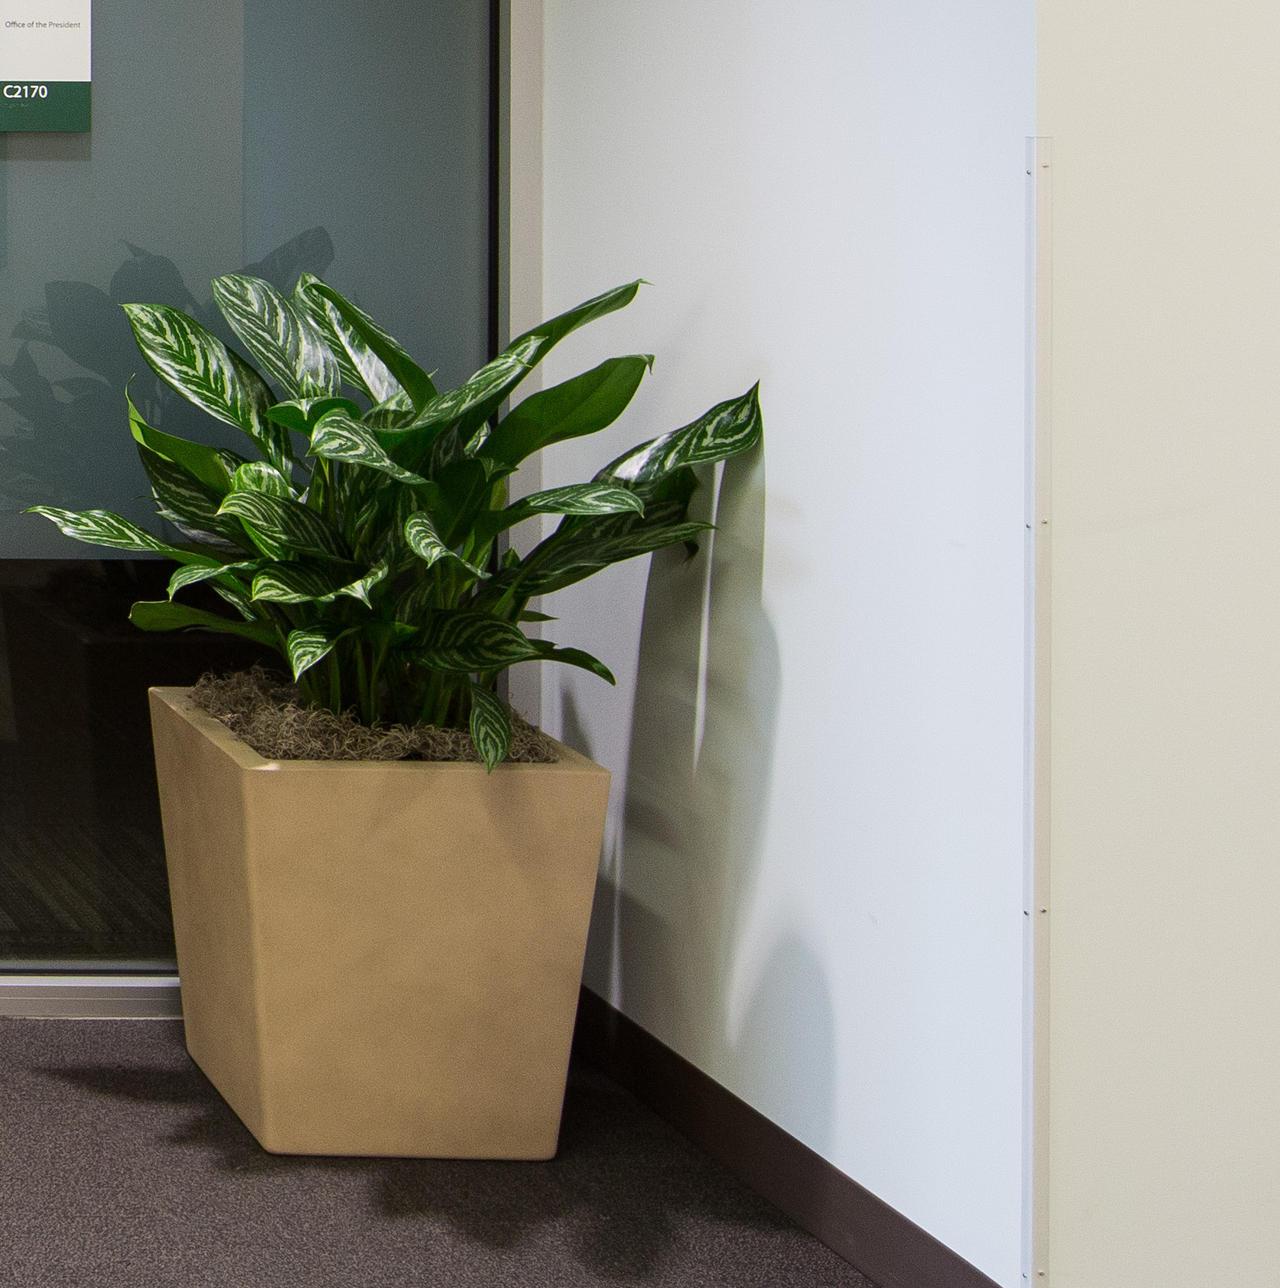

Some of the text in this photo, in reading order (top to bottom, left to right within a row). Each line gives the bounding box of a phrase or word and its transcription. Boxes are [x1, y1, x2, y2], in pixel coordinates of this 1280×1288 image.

[4, 20, 81, 29] Office of the President
[3, 85, 48, 98] C2170
